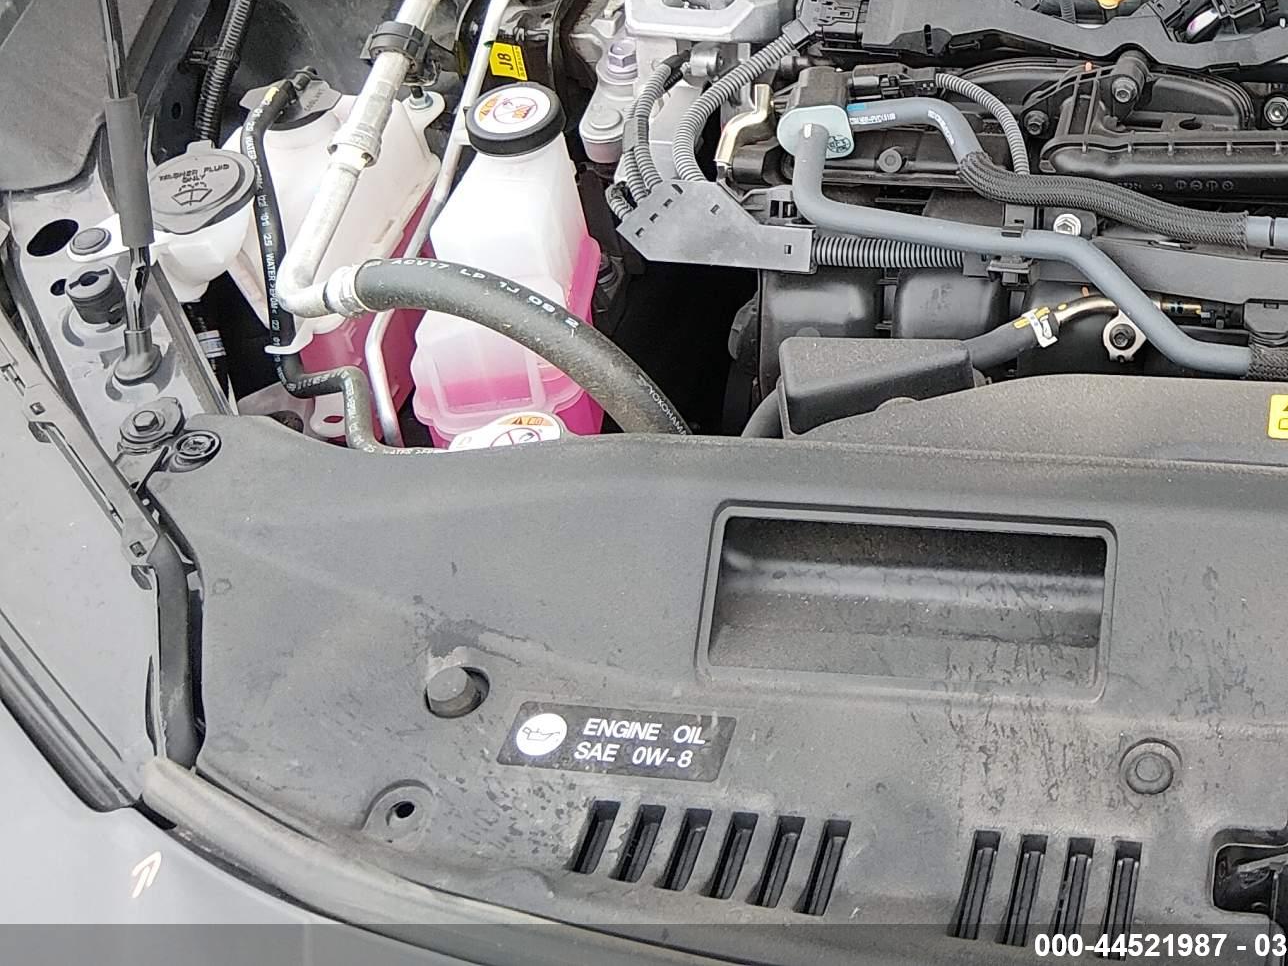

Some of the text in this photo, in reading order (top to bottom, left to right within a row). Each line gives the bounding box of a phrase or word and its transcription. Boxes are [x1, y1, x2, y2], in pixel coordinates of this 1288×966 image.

[497, 52, 514, 70] J8
[181, 173, 206, 184] ONLY
[203, 163, 230, 174] FLUID
[265, 252, 277, 286] WATER
[582, 717, 707, 745] ENGINE OIL
[573, 742, 694, 768] SAE 0W-8
